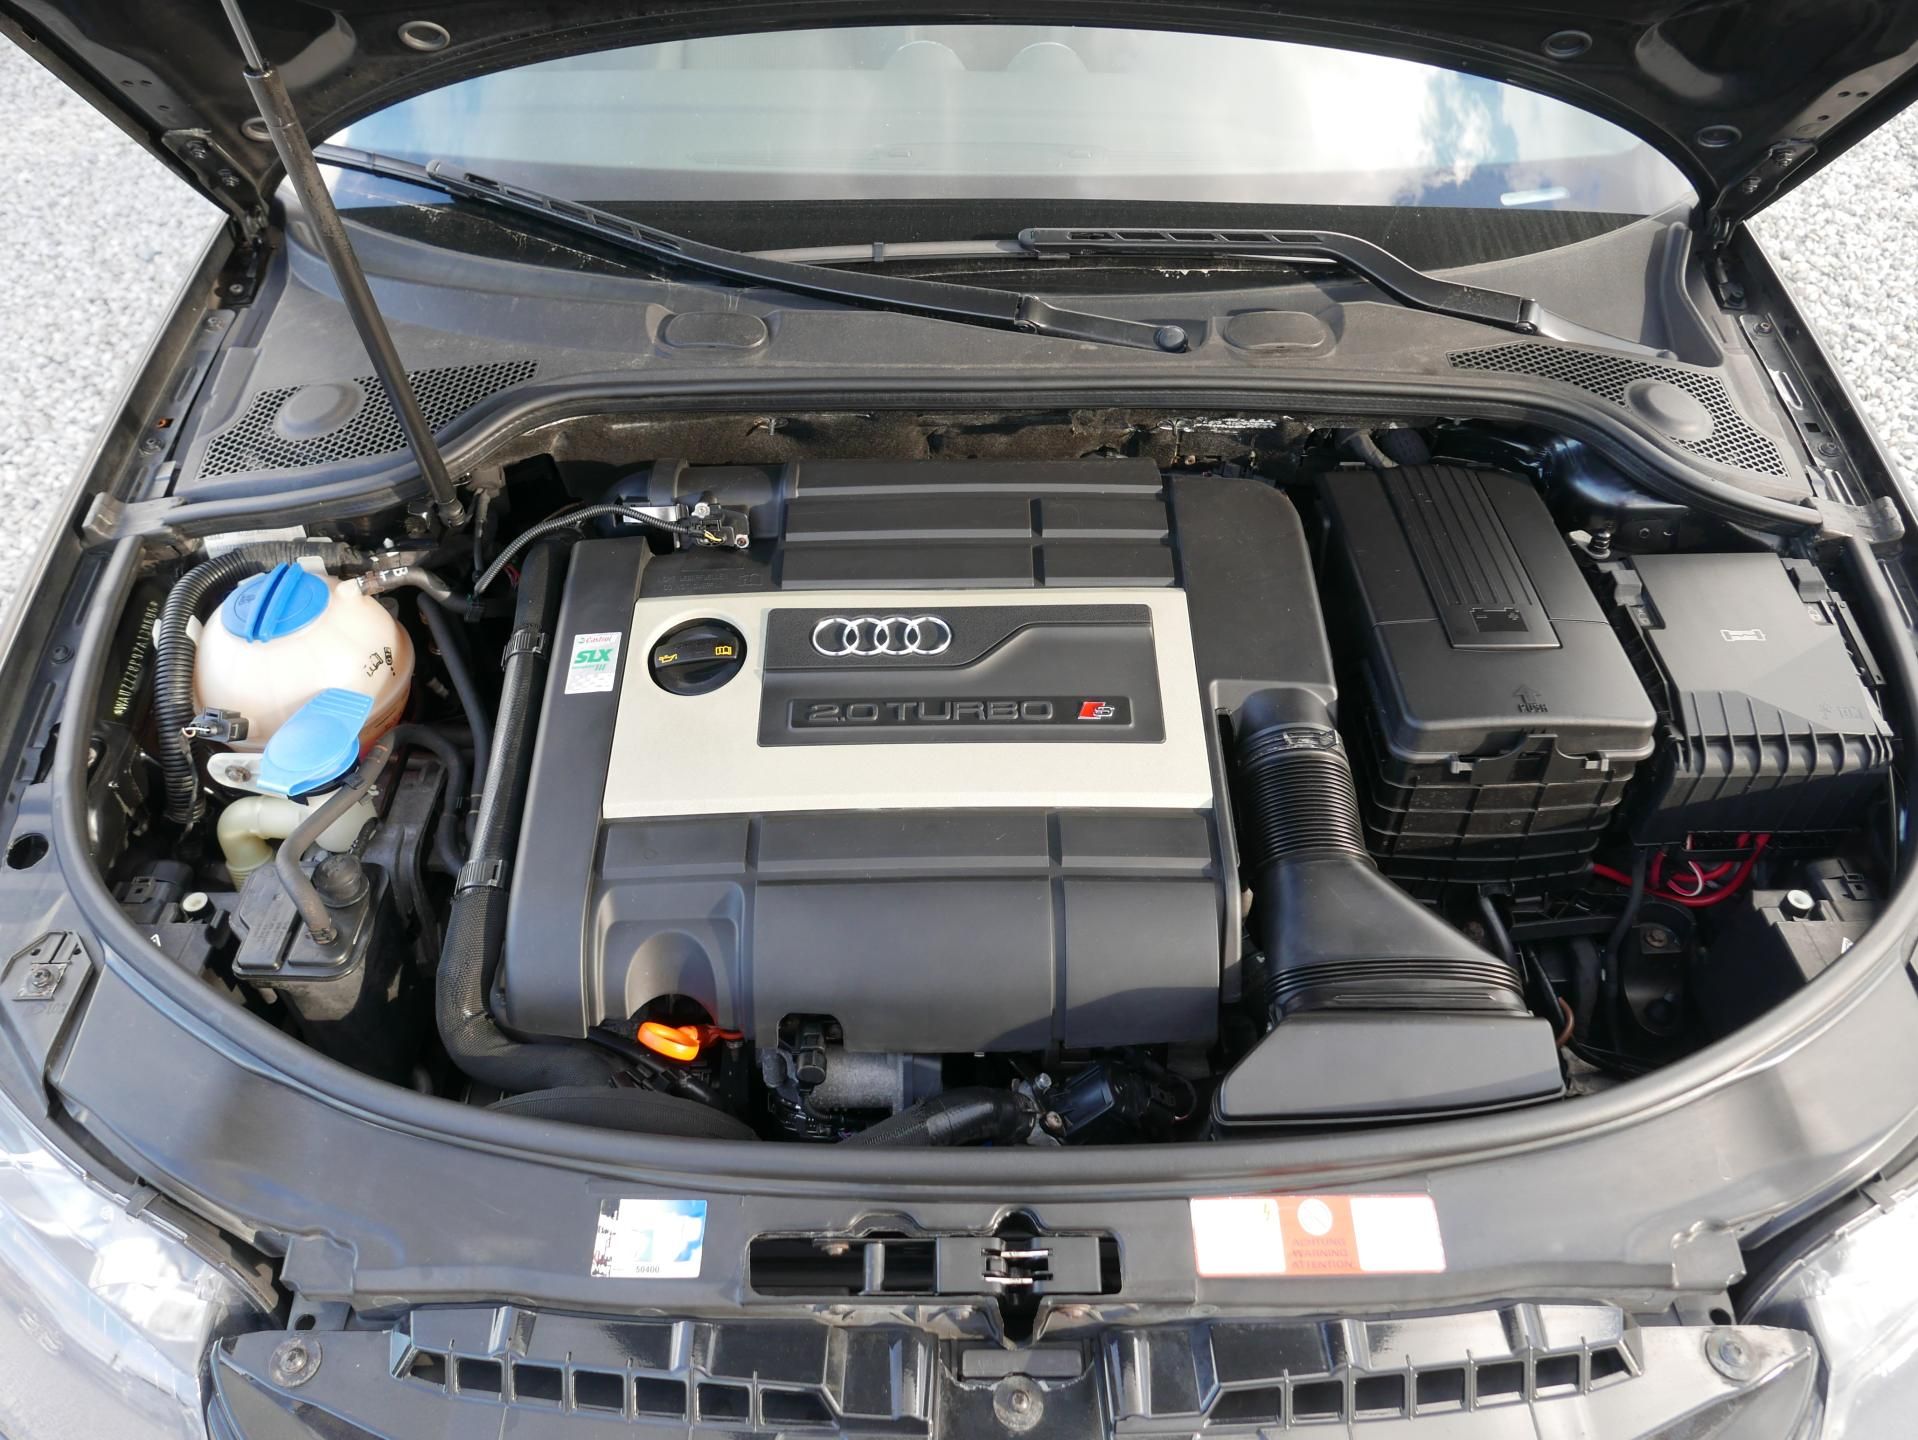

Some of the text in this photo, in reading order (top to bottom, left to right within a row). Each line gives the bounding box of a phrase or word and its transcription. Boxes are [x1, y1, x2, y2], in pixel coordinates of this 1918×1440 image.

[574, 648, 613, 664] SLX
[808, 702, 880, 723] 2.0
[885, 701, 1054, 721] TURBO
[1292, 1248, 1349, 1258] WARNING
[1292, 1260, 1354, 1269] ATTENTION
